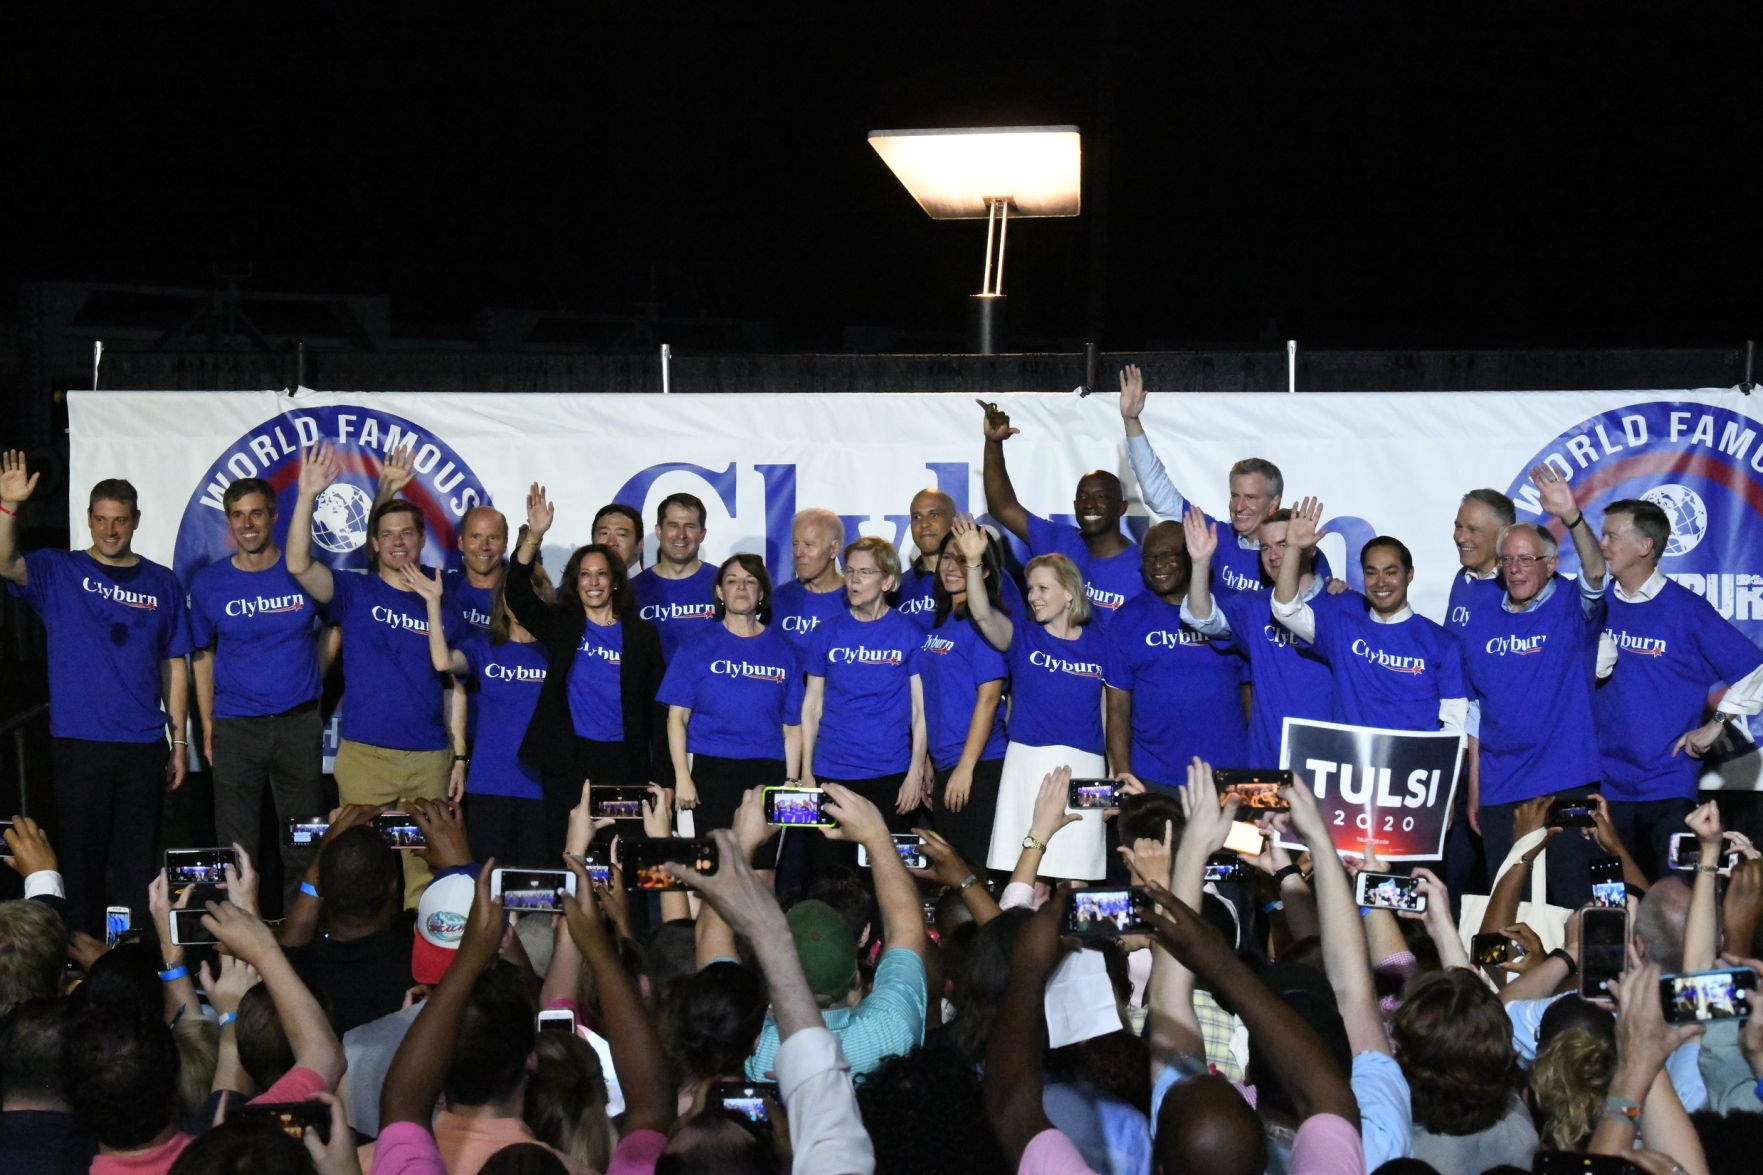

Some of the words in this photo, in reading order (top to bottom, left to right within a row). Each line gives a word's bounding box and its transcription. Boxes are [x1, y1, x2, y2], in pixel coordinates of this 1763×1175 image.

[200, 416, 319, 513] WORLD
[338, 414, 481, 517] FAMOUS
[1513, 415, 1649, 517] WORLD
[1222, 565, 1265, 591] Clybu
[82, 576, 158, 608] Clyburn
[898, 595, 937, 614] Clyb
[225, 593, 304, 618] Clyburn
[639, 602, 716, 622] Clyburn
[1605, 627, 1667, 653] lyburn
[828, 646, 902, 664] Clyburn
[1351, 638, 1426, 672] Clyburn
[710, 660, 786, 680] Clyburn
[1306, 758, 1441, 809] TULSI
[1333, 810, 1415, 832] 2020
